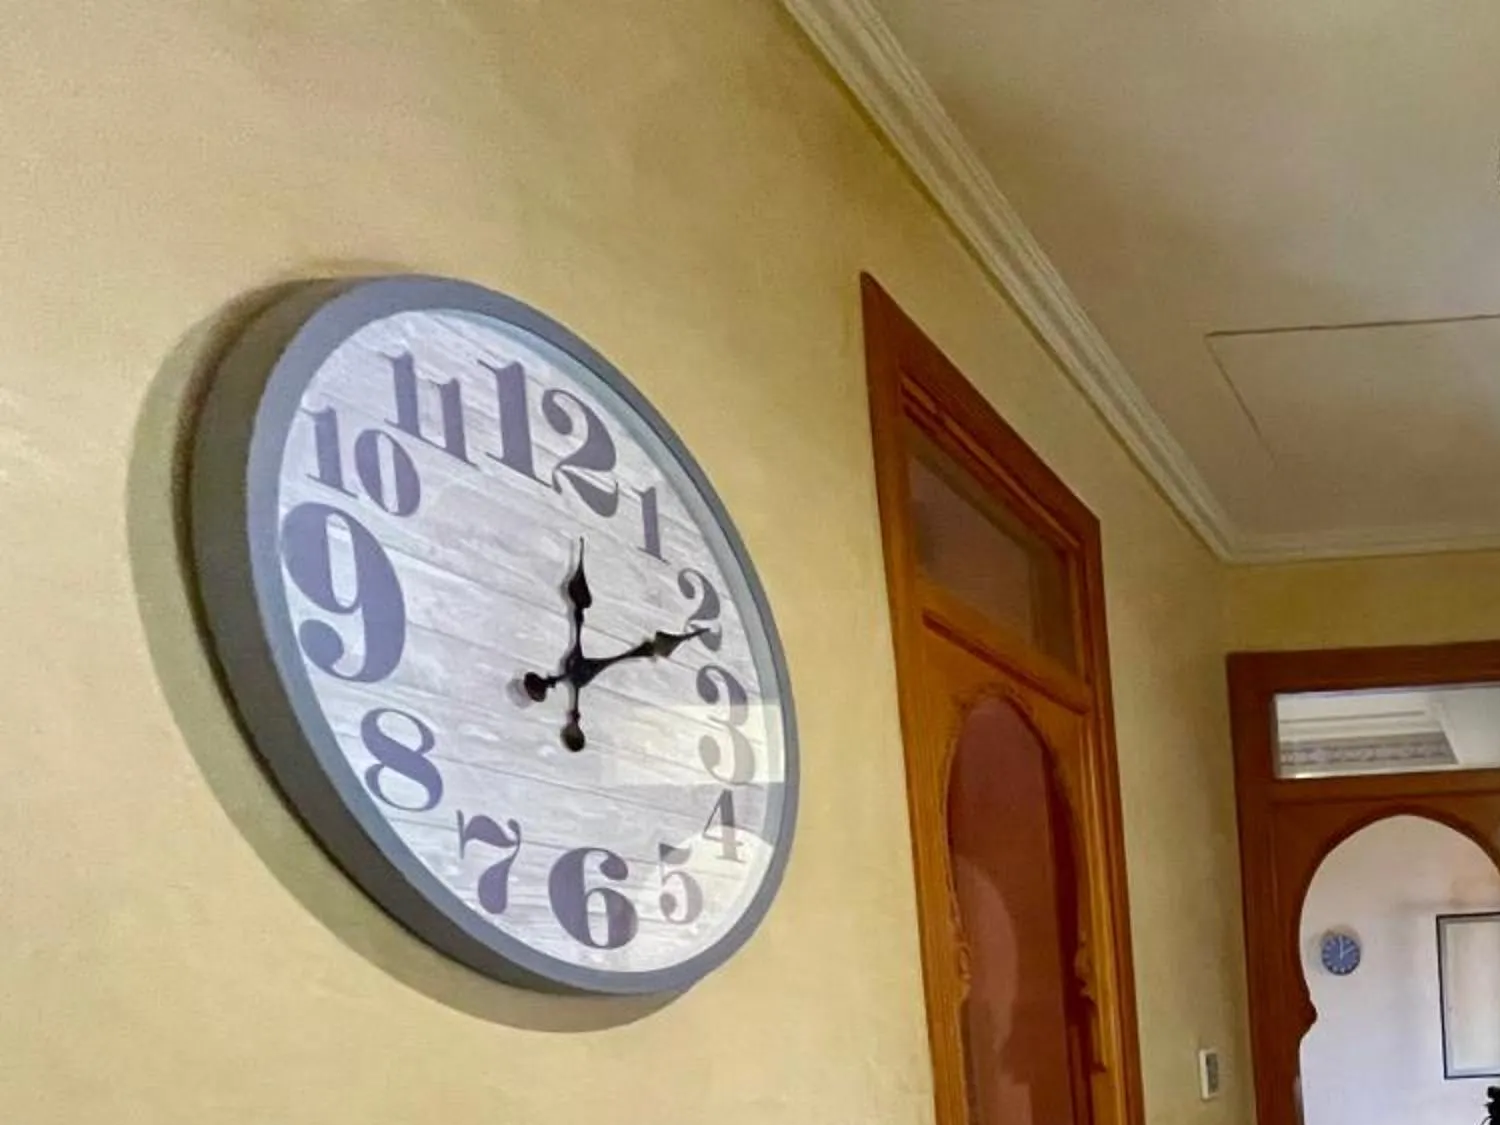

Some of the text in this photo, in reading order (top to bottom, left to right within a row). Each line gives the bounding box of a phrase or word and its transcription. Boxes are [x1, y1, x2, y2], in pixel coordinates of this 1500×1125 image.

[301, 406, 421, 517] 10
[380, 351, 479, 468] 11
[478, 360, 619, 518] 12
[628, 487, 669, 563] 1
[281, 502, 406, 683] 9
[677, 569, 721, 651] 2
[359, 708, 444, 813] 8
[695, 664, 755, 787] 3
[456, 808, 521, 915] 7
[702, 790, 746, 863] 4
[548, 846, 639, 949] 6
[657, 843, 701, 925] 5
